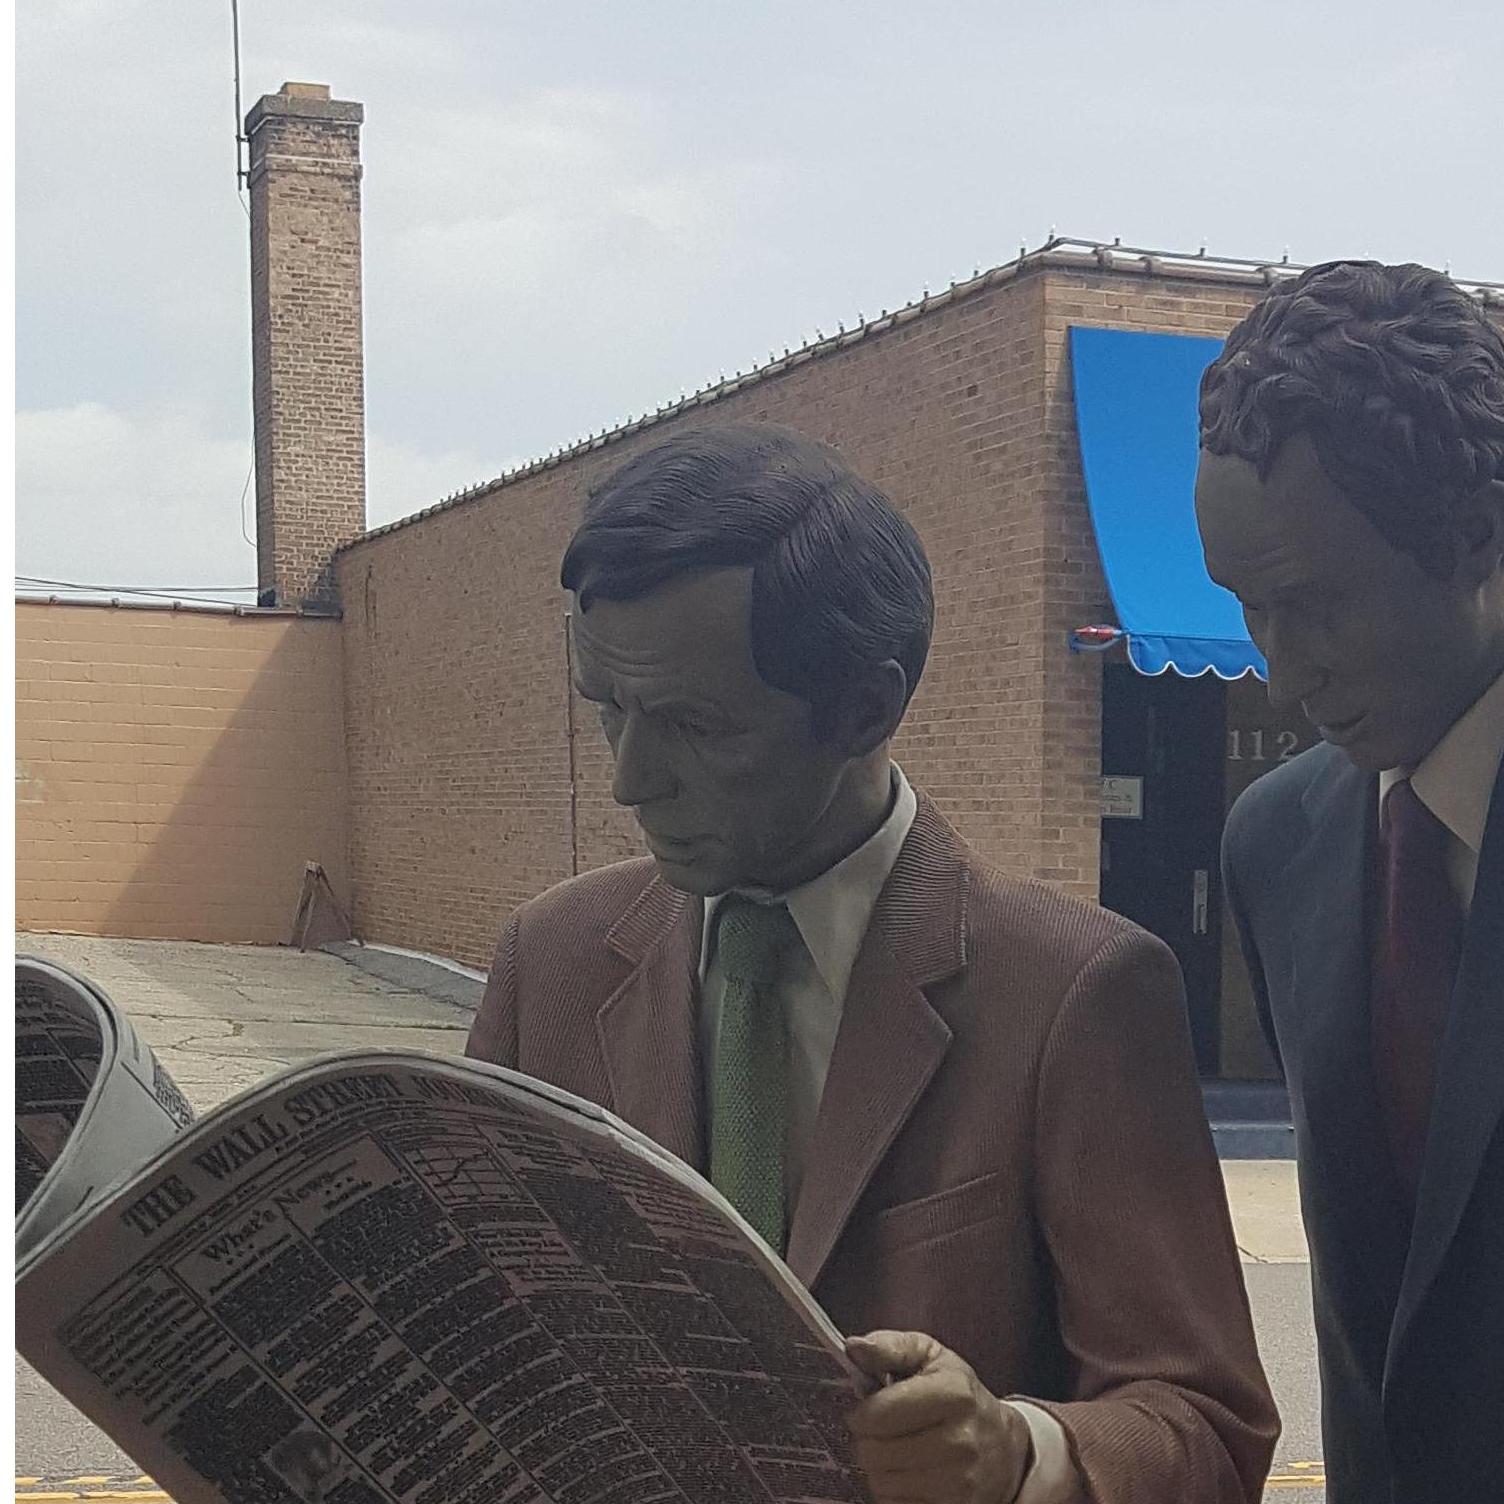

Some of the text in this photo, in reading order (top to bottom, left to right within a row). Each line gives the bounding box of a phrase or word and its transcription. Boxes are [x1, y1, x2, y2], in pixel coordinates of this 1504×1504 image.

[1227, 729, 1298, 761] 112
[120, 1173, 196, 1238] THE
[193, 1113, 290, 1180] WALL
[201, 1208, 279, 1261] What's
